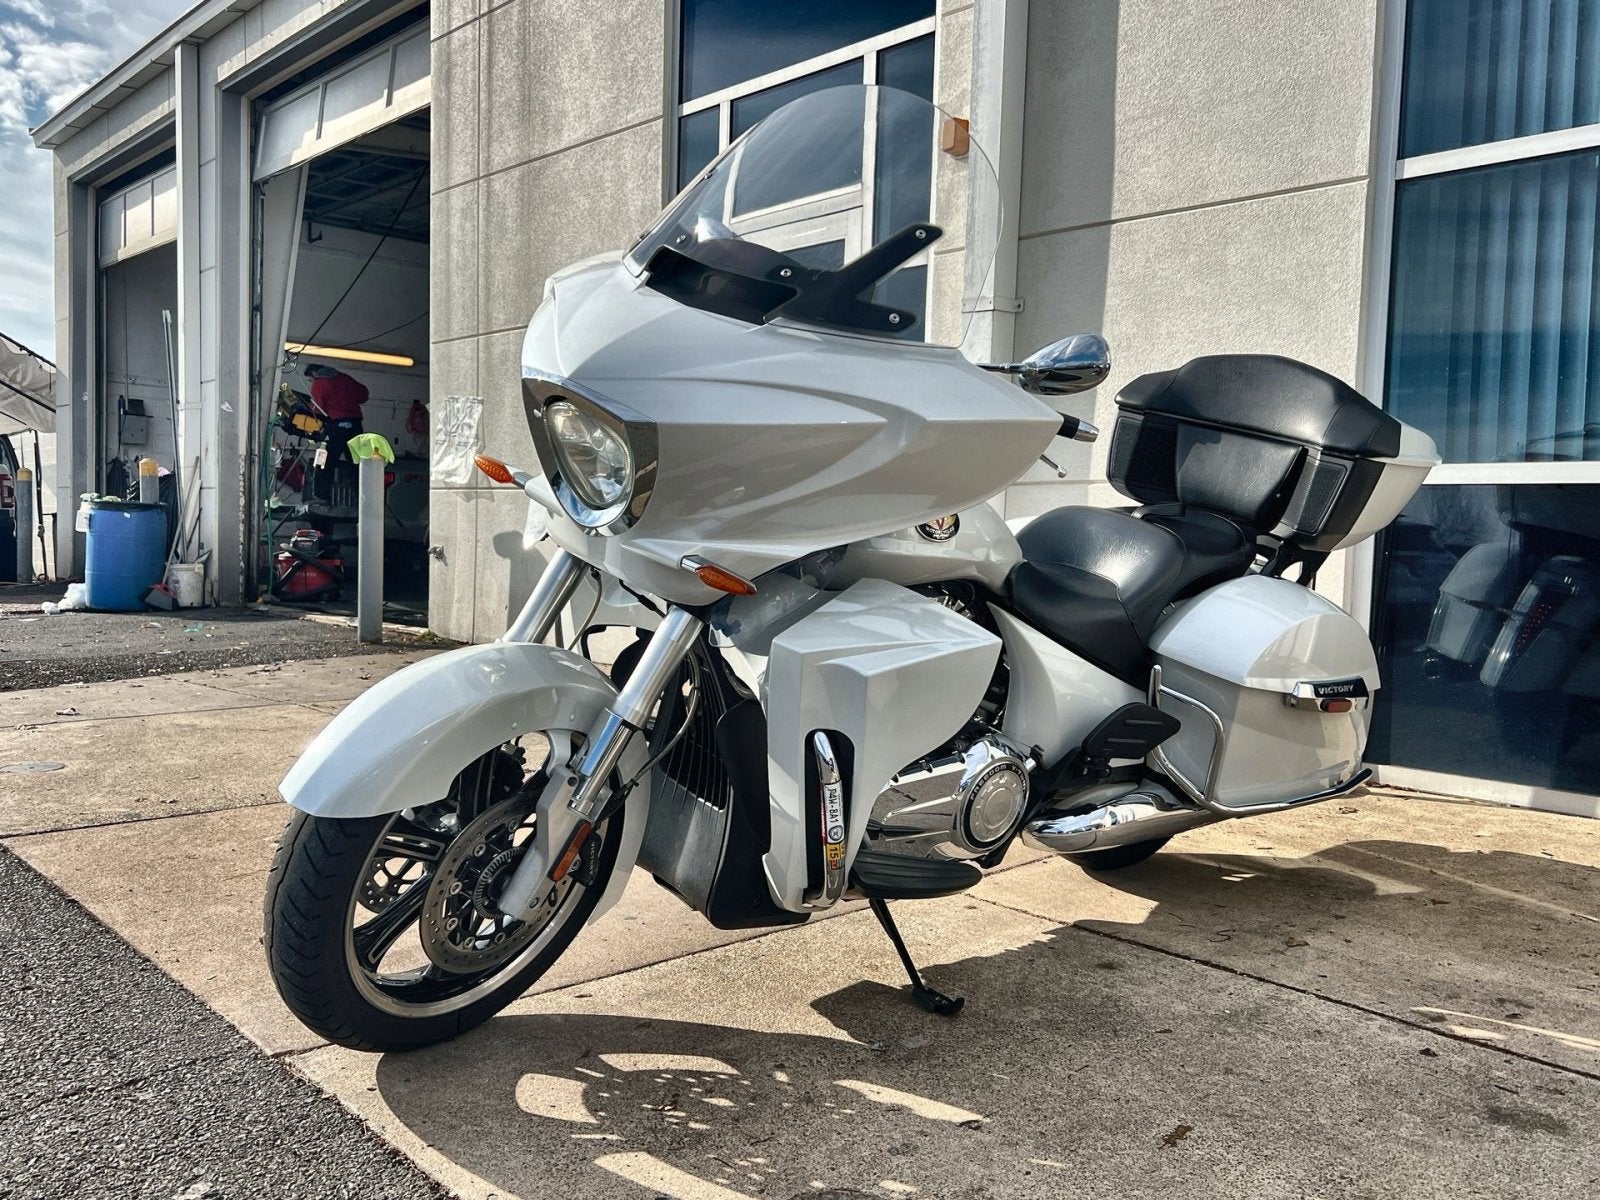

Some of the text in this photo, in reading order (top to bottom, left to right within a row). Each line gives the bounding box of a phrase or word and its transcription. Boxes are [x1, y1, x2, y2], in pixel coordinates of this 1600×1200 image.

[1317, 684, 1354, 695] VICTORY
[970, 764, 1007, 801] FREEDOM
[830, 846, 839, 859] 15
